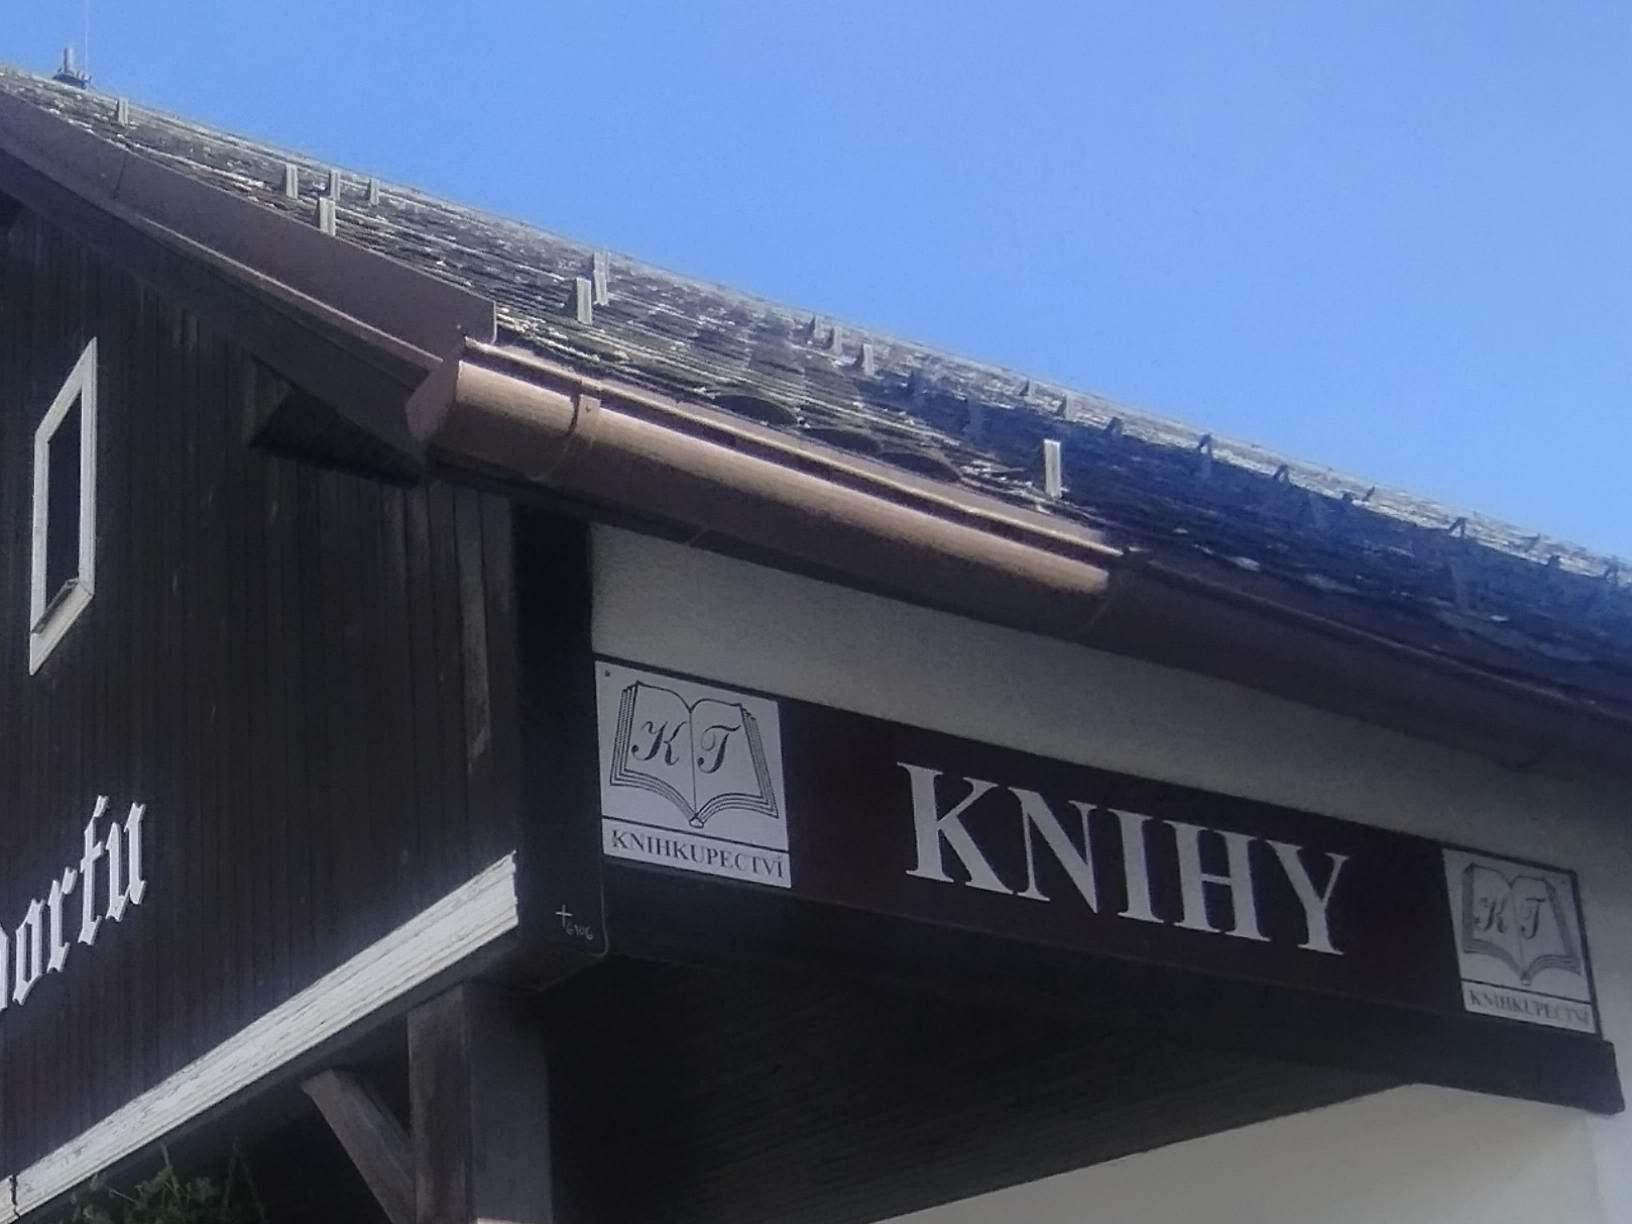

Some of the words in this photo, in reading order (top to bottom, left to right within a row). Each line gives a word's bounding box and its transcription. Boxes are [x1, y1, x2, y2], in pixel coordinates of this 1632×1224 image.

[631, 720, 687, 767] K
[611, 829, 784, 879] KNIHKUPECTVÍ
[896, 761, 1350, 956] KNIHY
[1469, 989, 1590, 1025] KNIHKUPECTVÍ
